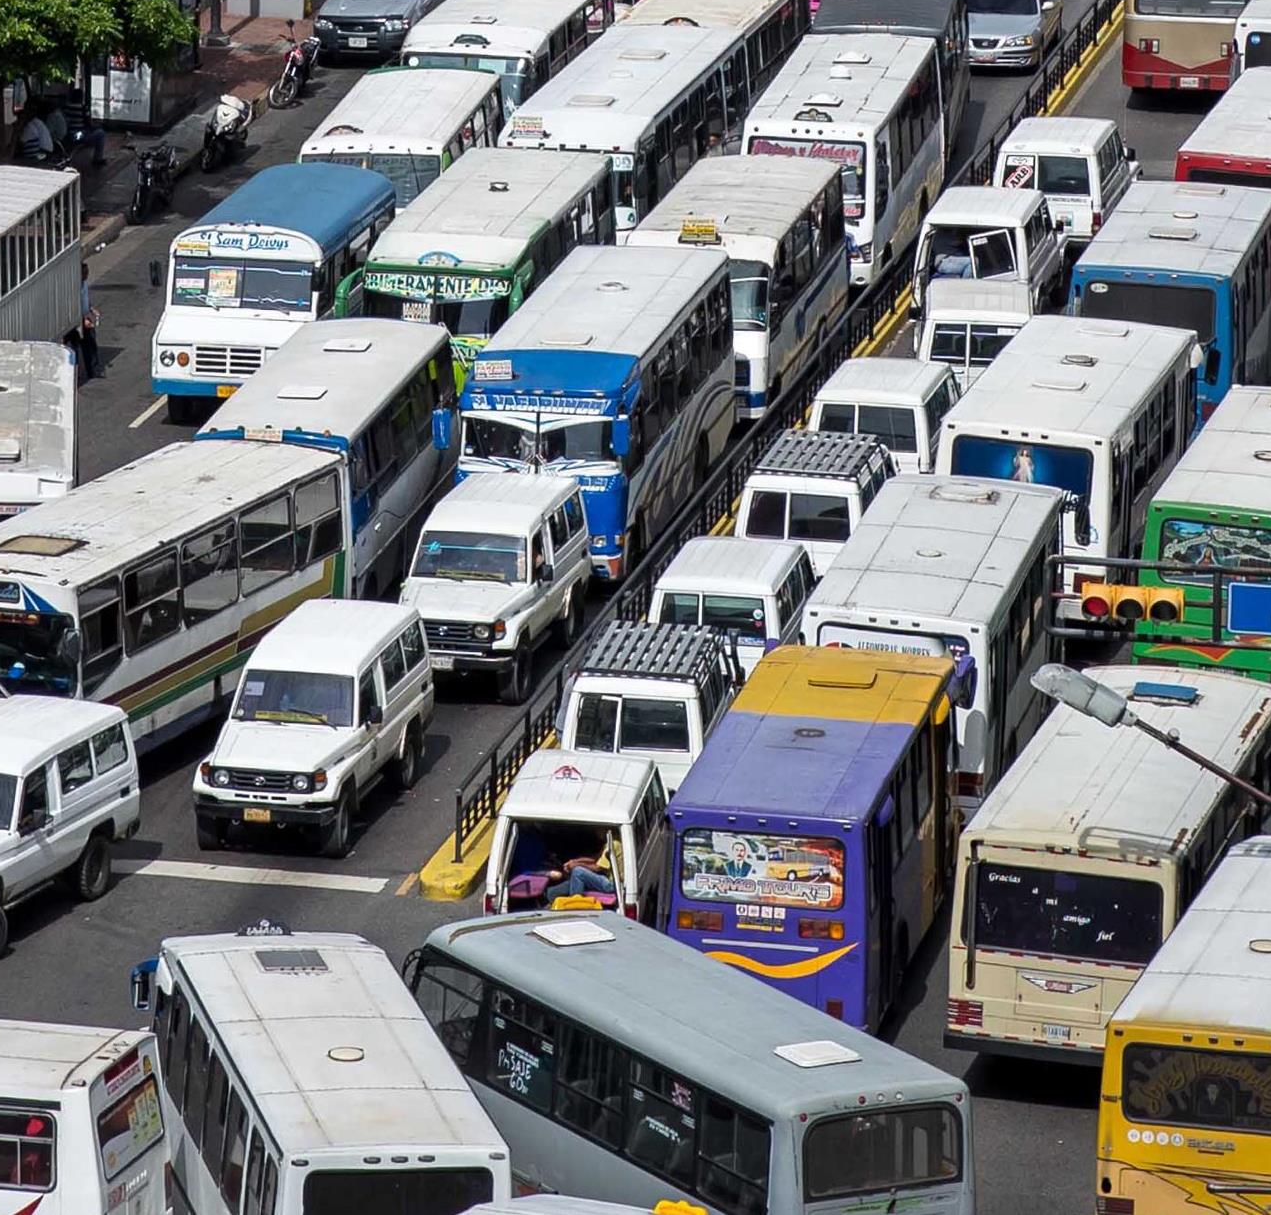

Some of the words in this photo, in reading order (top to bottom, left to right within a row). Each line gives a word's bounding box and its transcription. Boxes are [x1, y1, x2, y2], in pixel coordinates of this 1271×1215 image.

[1010, 167, 1029, 188] ARB
[988, 872, 1021, 884] Gracias
[1045, 897, 1058, 906] mi
[1063, 913, 1091, 926] amigo
